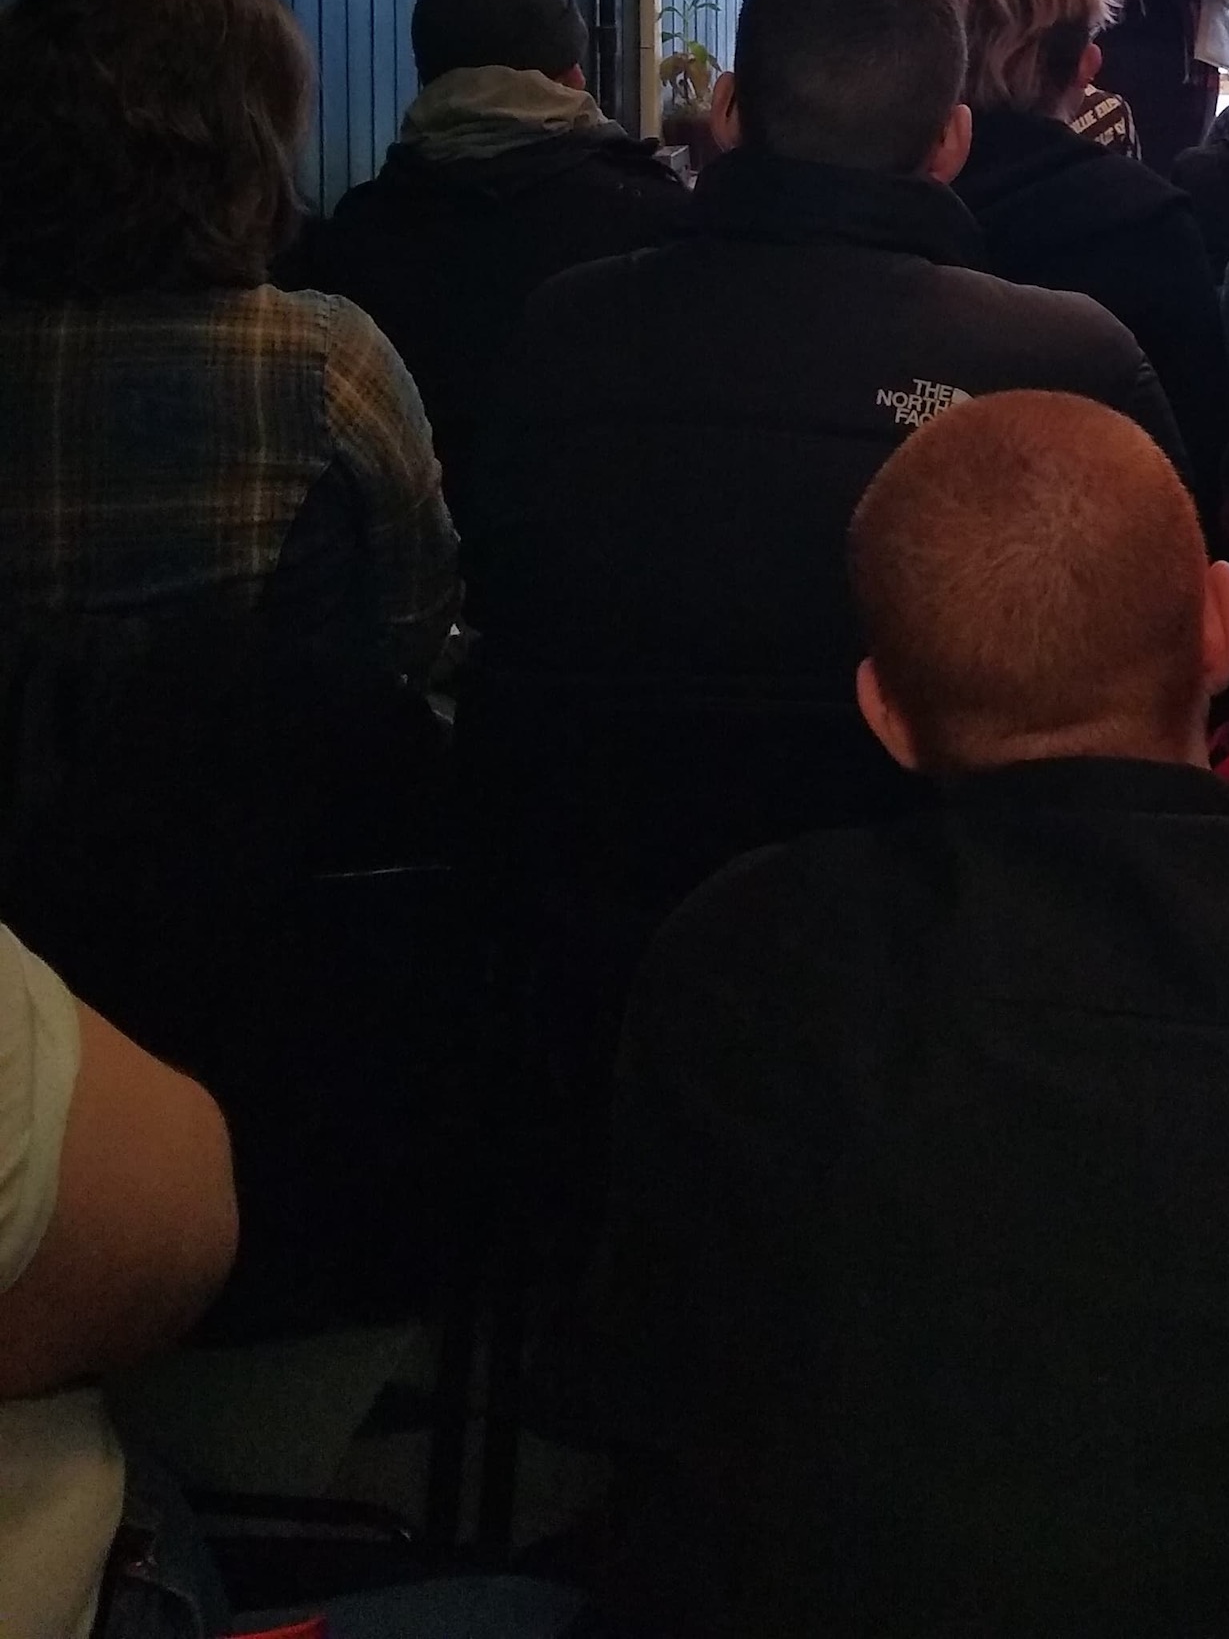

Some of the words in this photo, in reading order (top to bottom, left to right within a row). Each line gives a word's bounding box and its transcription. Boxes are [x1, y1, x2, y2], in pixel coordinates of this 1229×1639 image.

[912, 378, 955, 401] THE
[875, 388, 951, 415] NORTH
[894, 407, 935, 428] FAC
